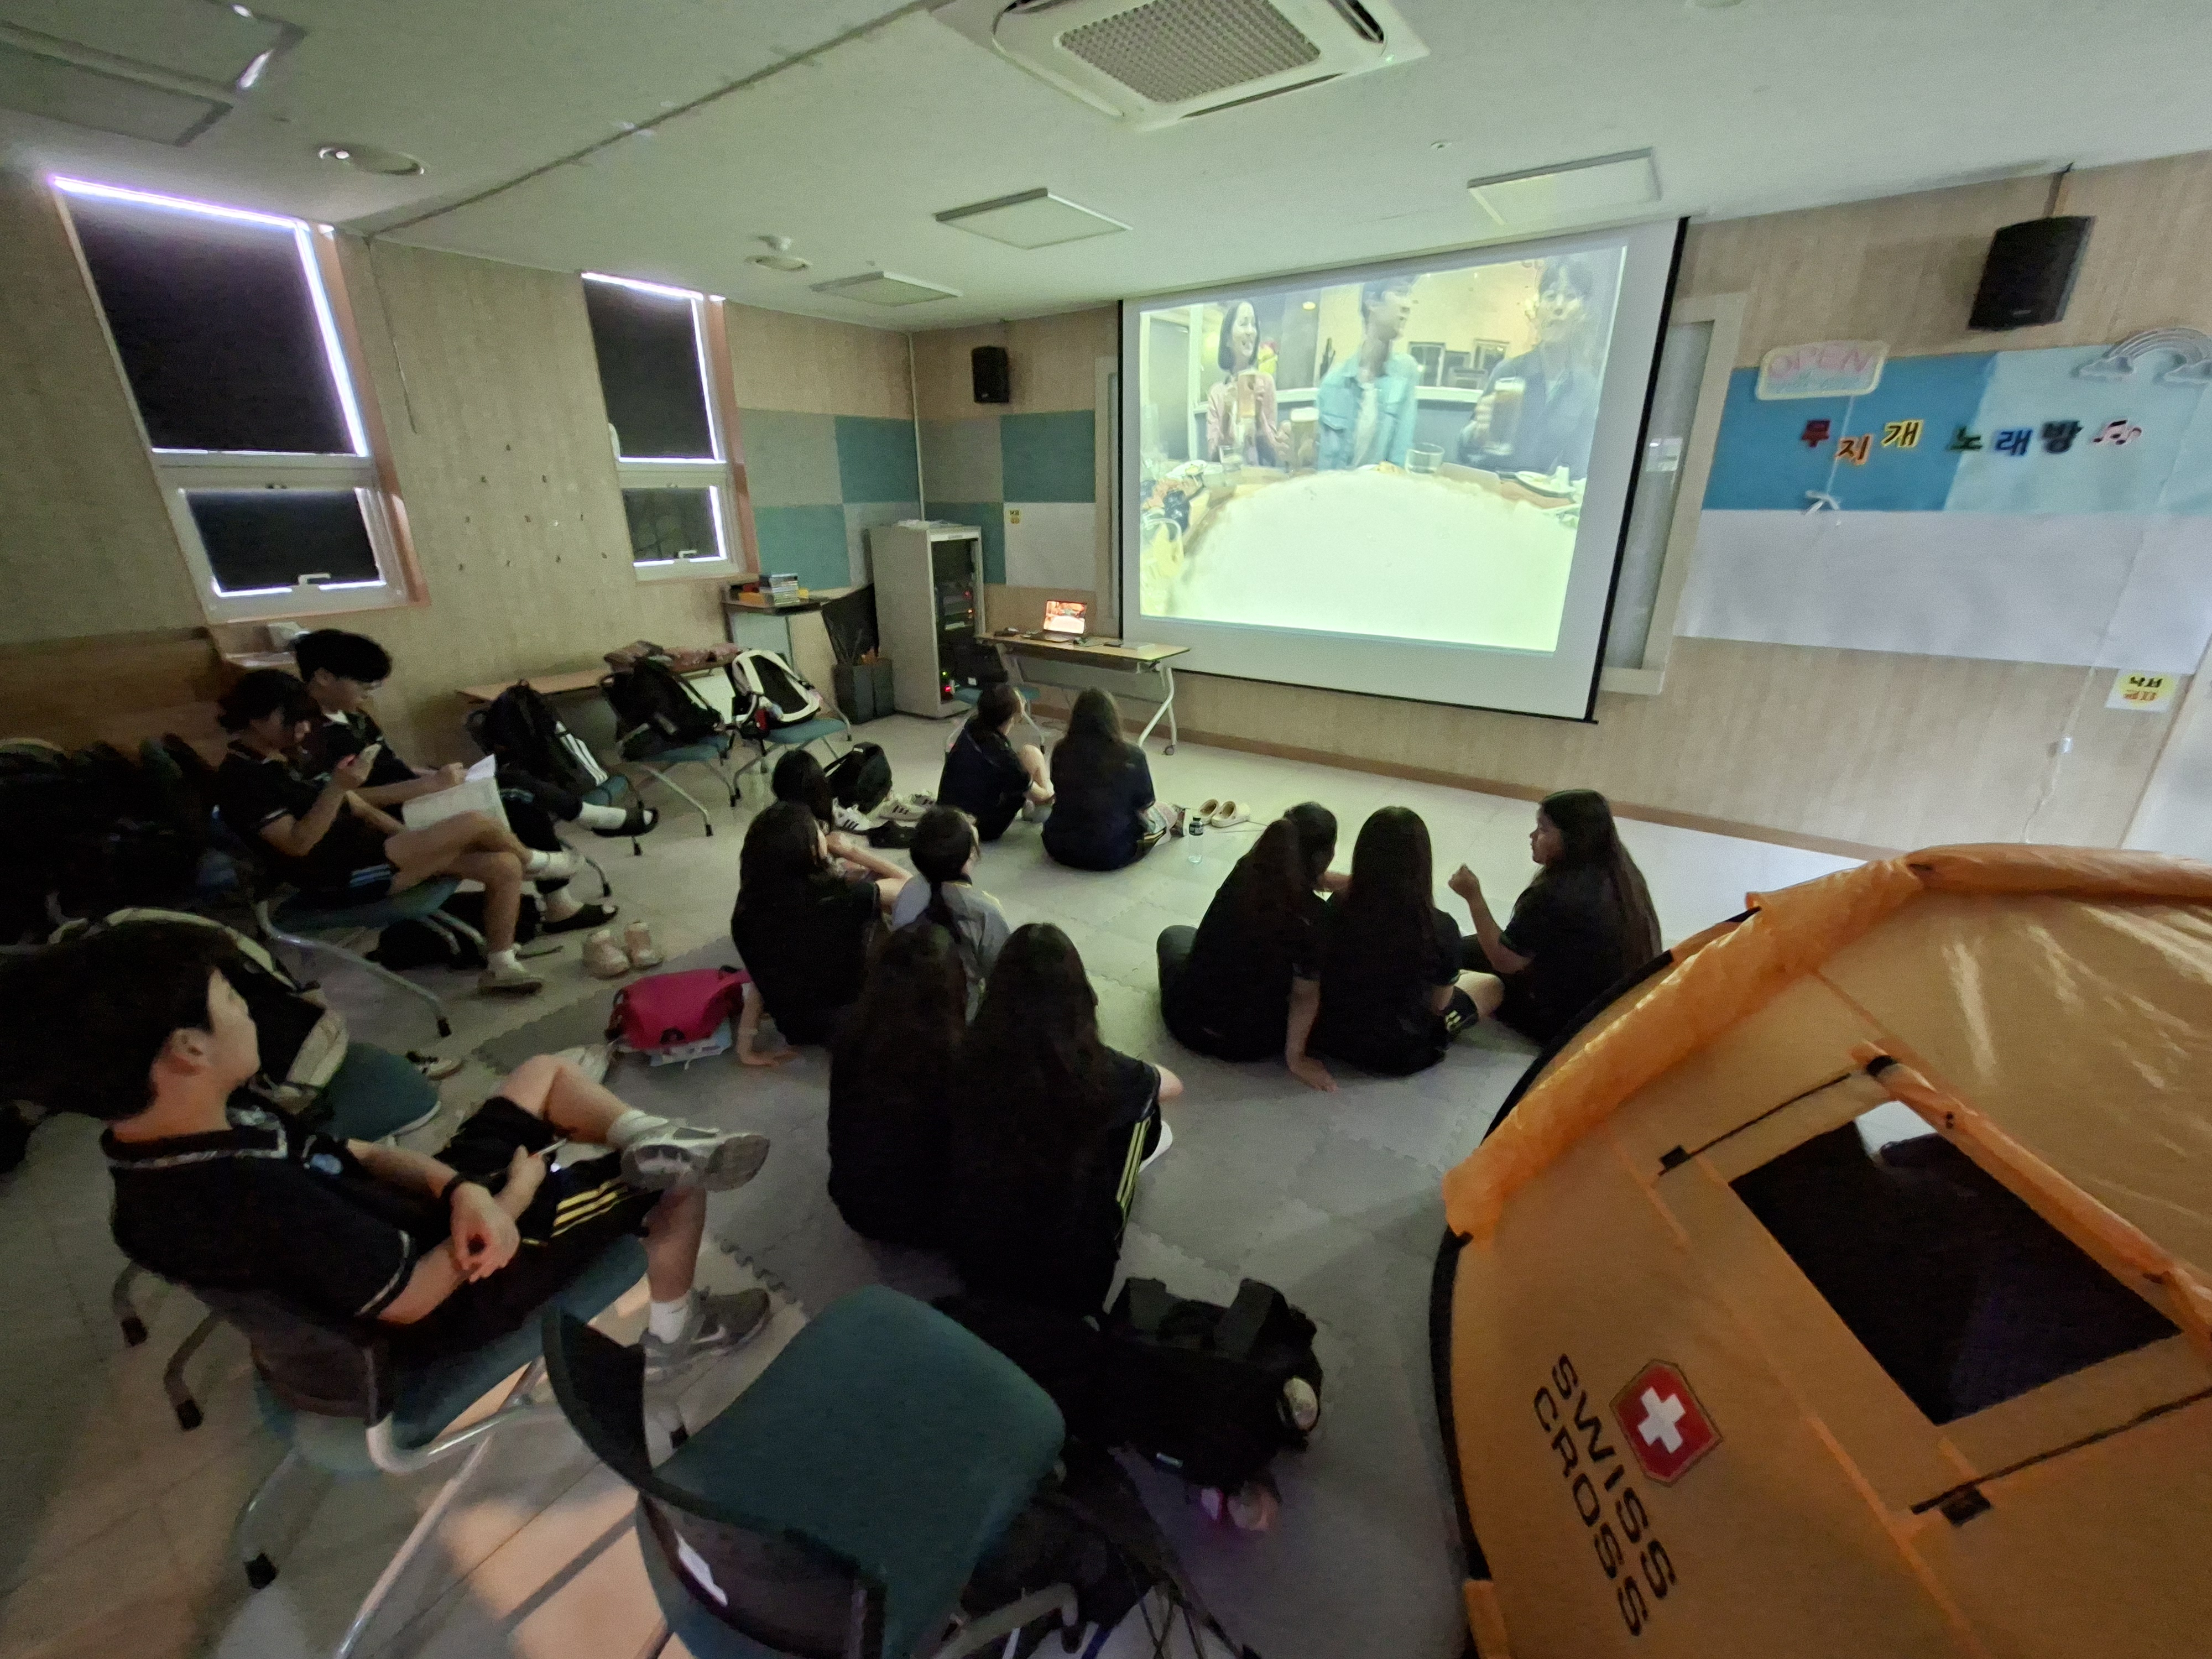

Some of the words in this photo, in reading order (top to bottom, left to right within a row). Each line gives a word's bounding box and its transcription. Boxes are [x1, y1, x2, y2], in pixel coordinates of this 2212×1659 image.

[1768, 341, 1872, 378] OPEN
[1801, 419, 1923, 465] 무지개
[1949, 420, 2084, 456] 노래방
[1533, 1386, 1648, 1636] CROSS
[1552, 1353, 1677, 1599] SWISS
